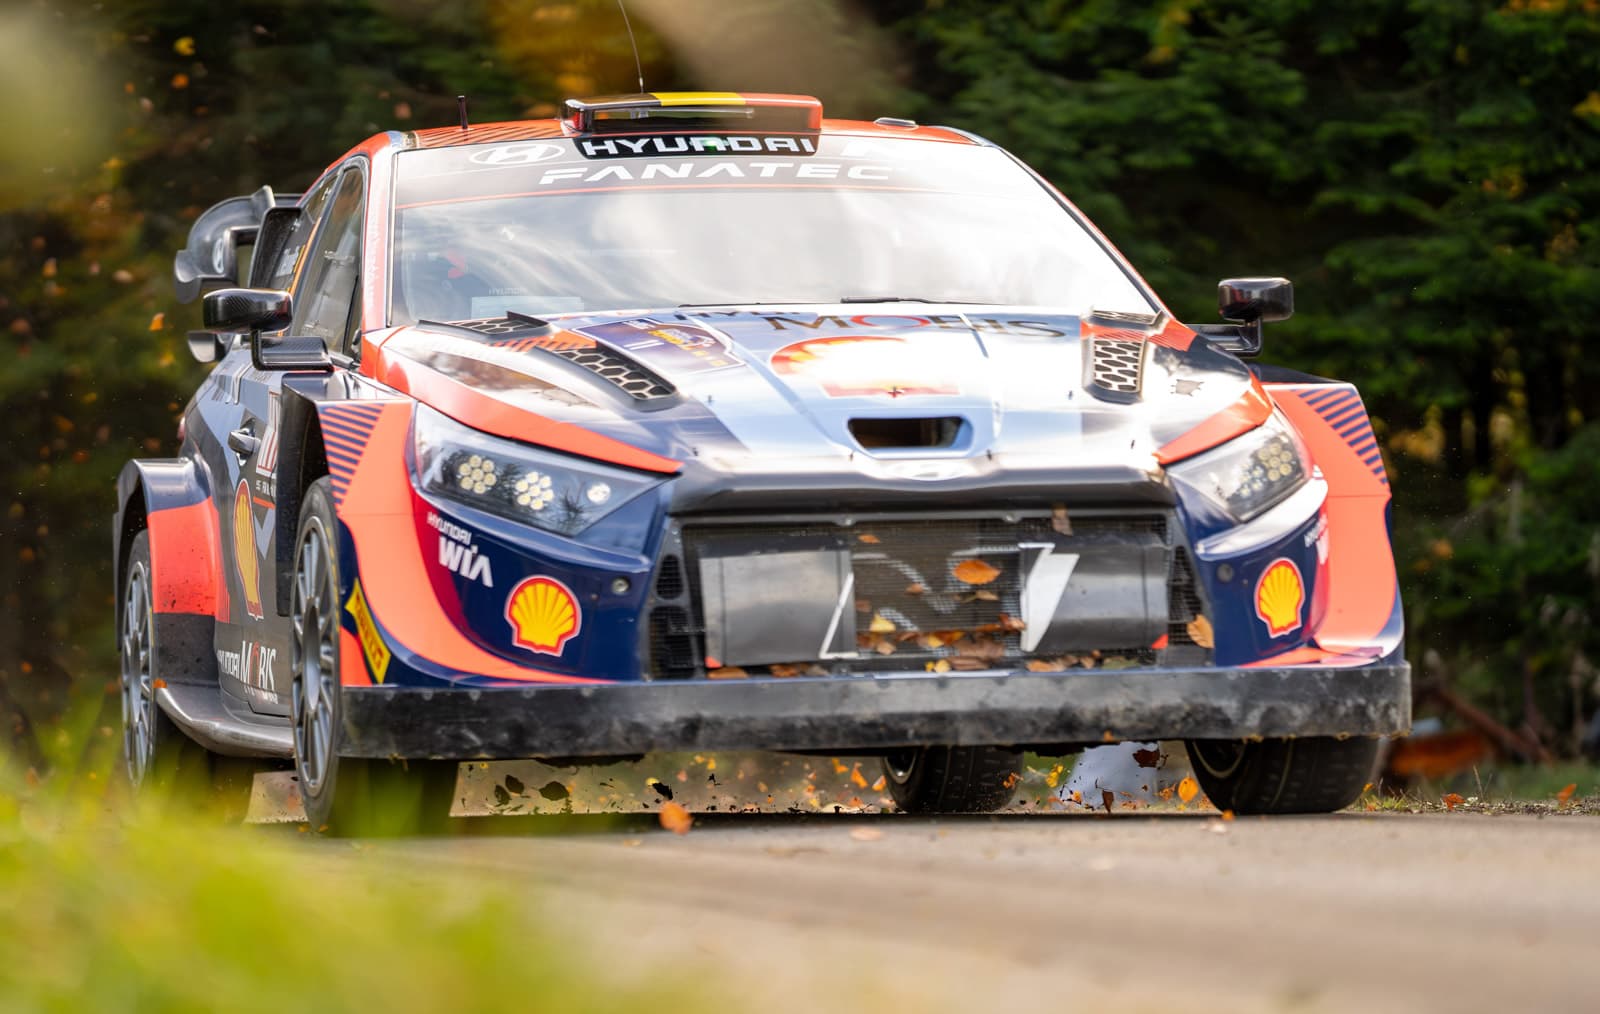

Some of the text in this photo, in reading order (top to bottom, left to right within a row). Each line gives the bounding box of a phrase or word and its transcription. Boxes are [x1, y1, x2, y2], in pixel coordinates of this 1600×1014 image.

[582, 135, 816, 156] HYUNDAI
[538, 162, 895, 185] FANATEC
[763, 313, 1067, 338] MOBIS
[426, 511, 472, 546] HYUNDAI
[438, 535, 494, 588] WIA
[240, 640, 277, 692] MOBIS
